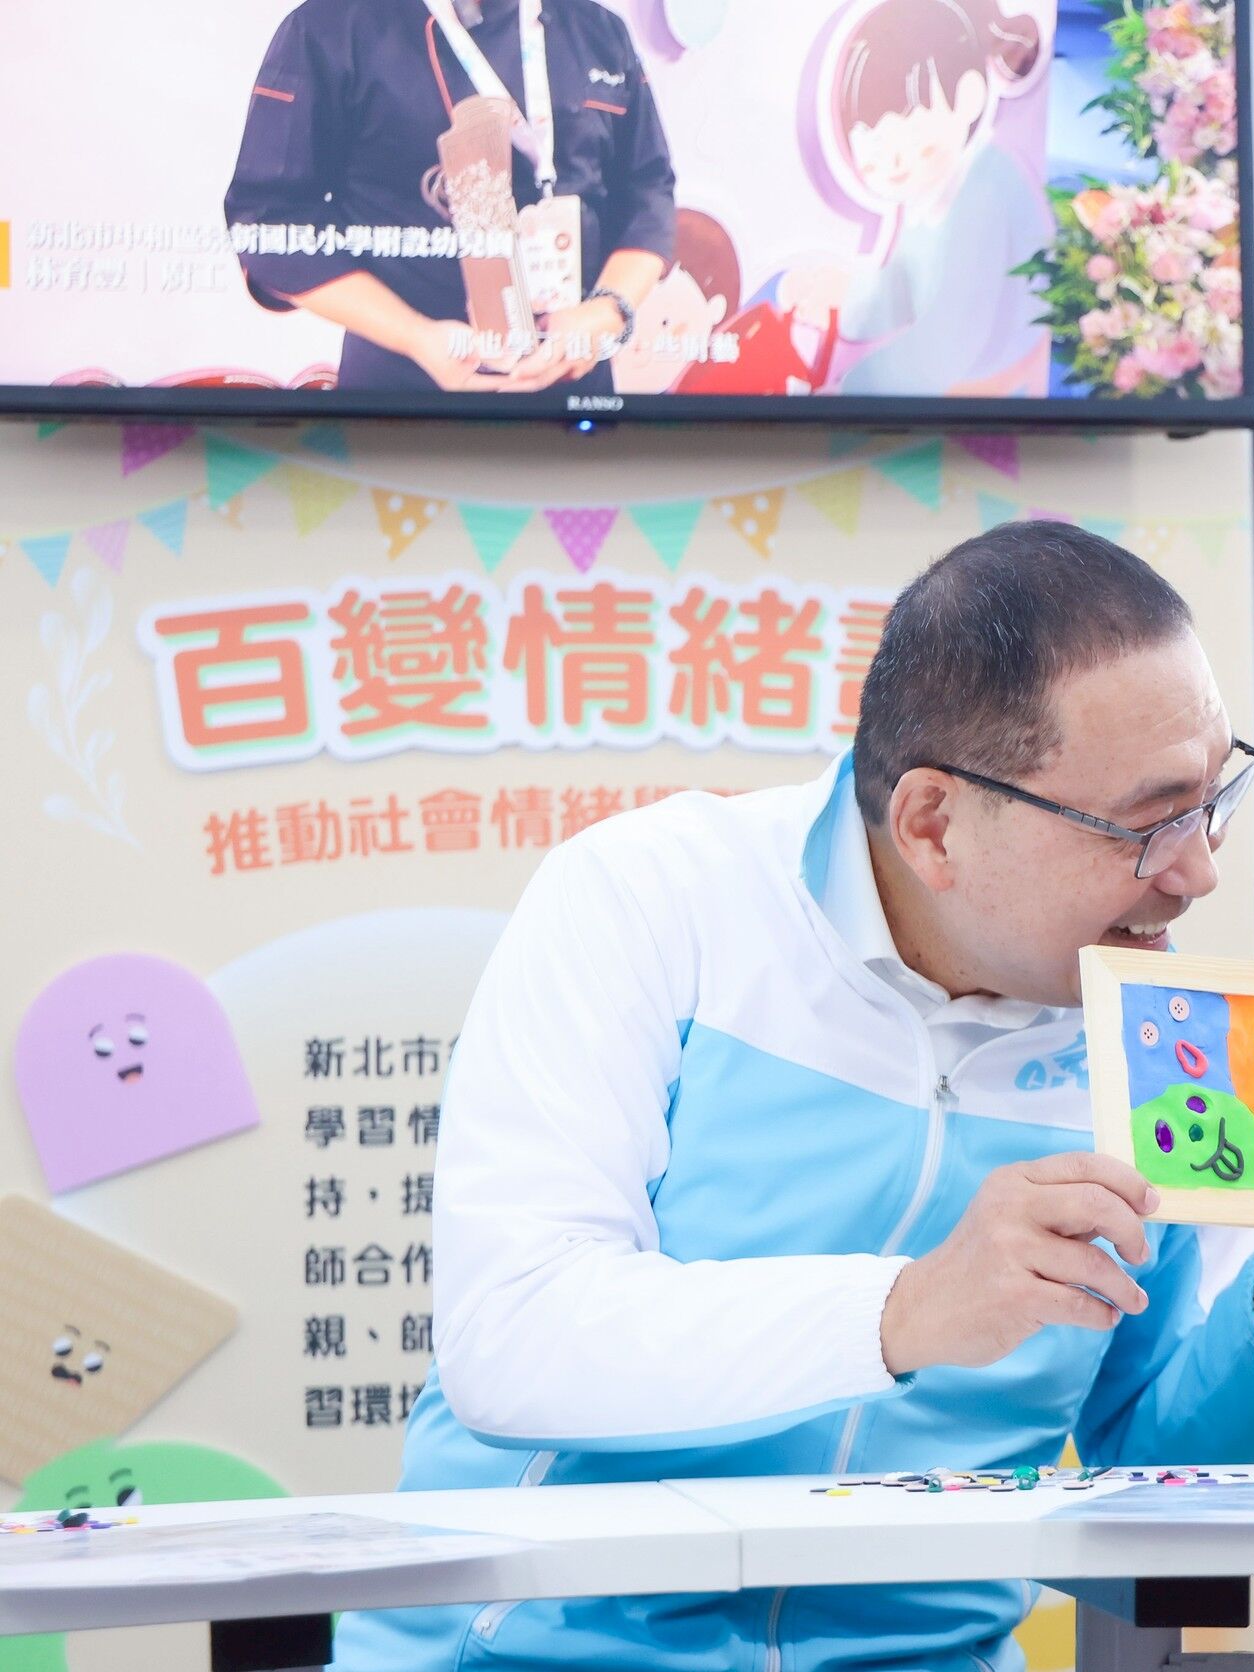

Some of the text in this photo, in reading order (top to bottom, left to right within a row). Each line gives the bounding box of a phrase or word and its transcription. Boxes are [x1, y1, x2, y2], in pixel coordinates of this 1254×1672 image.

[154, 582, 890, 749] 百變情緒
[203, 783, 750, 876] 推動社會情緒
[304, 1035, 459, 1078] 新北市
[305, 1105, 439, 1147] 學習情
[304, 1243, 433, 1286] 師合作
[304, 1313, 434, 1357] 親、師
